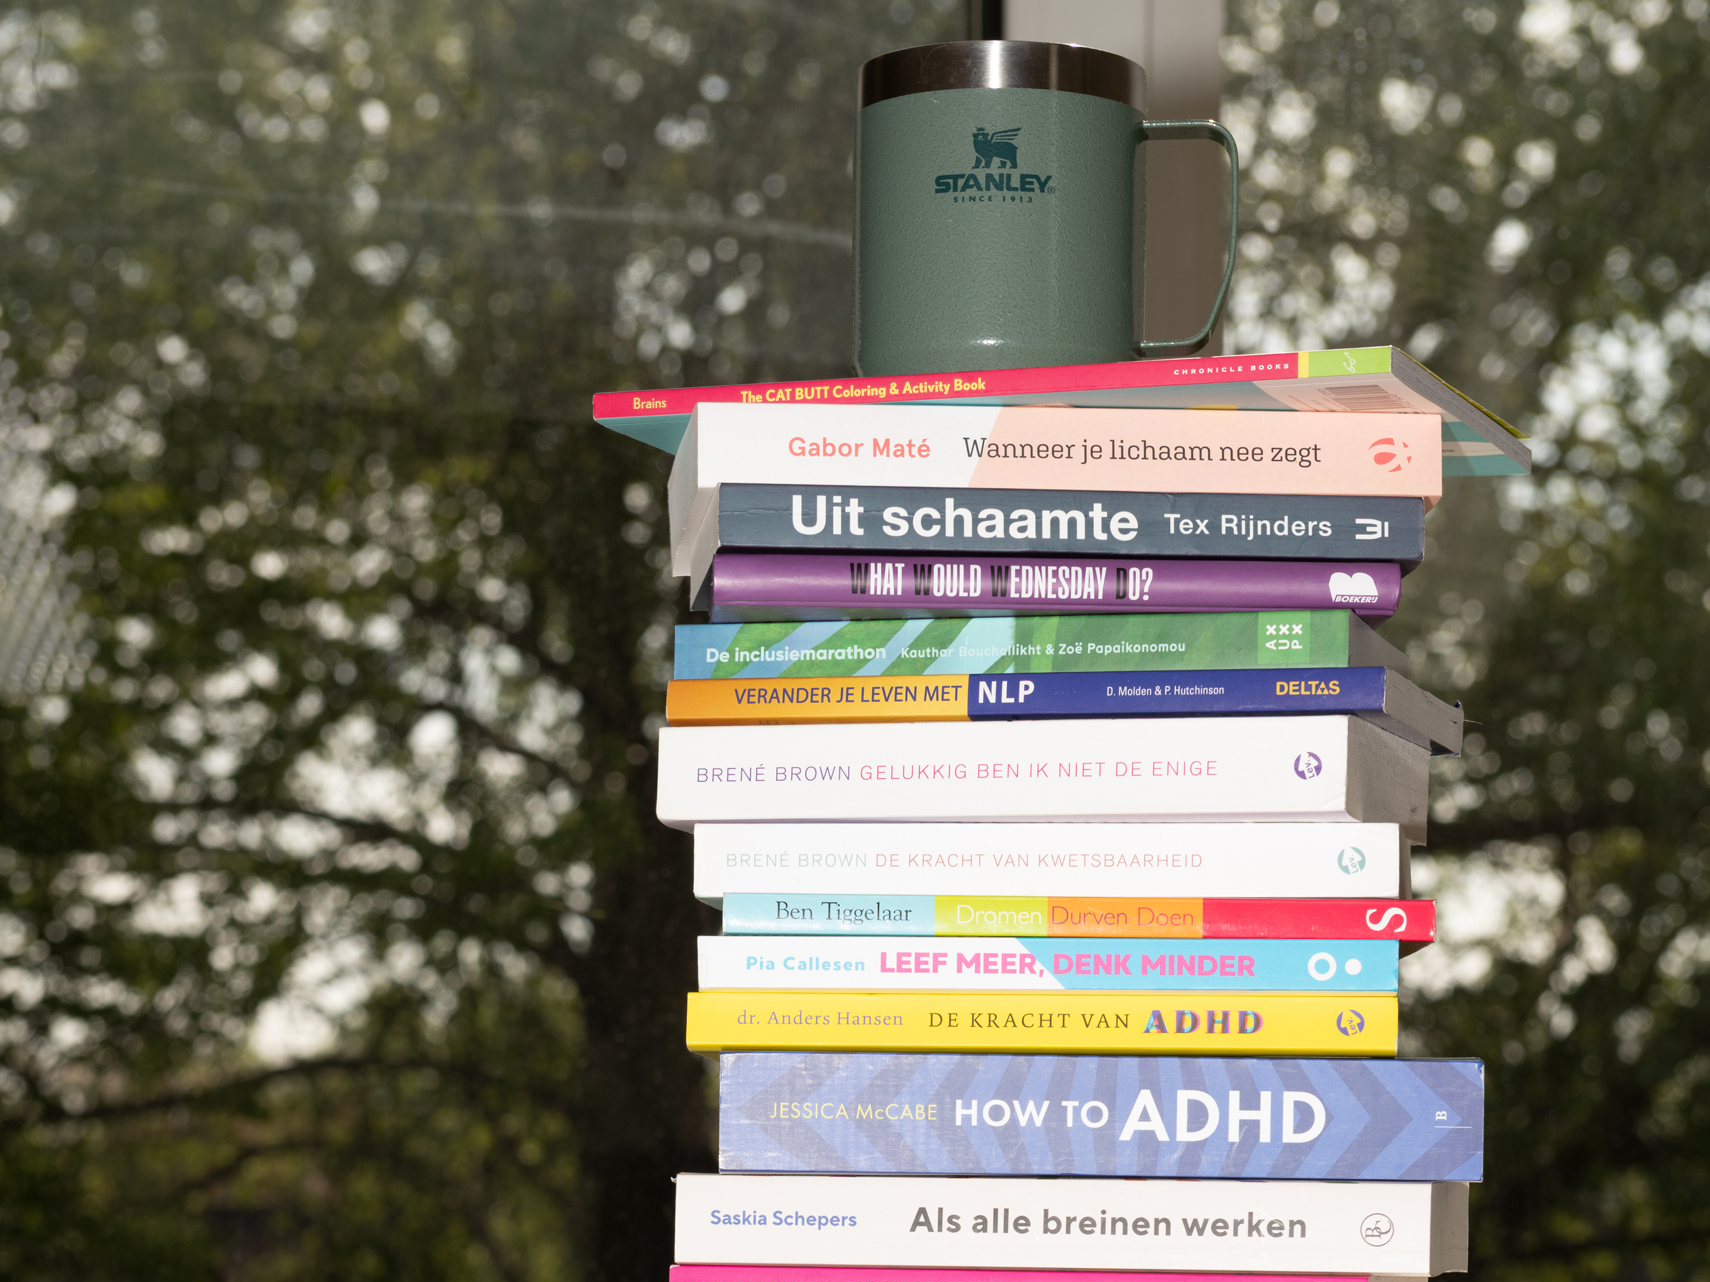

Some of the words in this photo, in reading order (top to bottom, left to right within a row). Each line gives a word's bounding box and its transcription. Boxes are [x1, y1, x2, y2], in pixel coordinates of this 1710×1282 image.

[953, 195, 993, 203] SINCE
[1002, 195, 1033, 203] 1913
[1173, 366, 1244, 376] CHRONICLE
[1250, 363, 1290, 373] BOOKS
[741, 391, 763, 403] The
[765, 388, 792, 402] CAT
[795, 386, 830, 400] BUTT
[832, 384, 887, 398] Coloring
[889, 382, 900, 395] &
[902, 380, 951, 395] Activity
[954, 377, 986, 392] Book
[633, 397, 667, 410] Brains
[788, 436, 864, 458] Gabor
[872, 437, 931, 459] Maté
[962, 437, 1075, 460] Wanneer
[1081, 440, 1103, 465] je
[1109, 439, 1213, 462] lichaam
[1218, 446, 1264, 462] nee
[1270, 443, 1322, 468] zegt
[792, 495, 865, 536] Uit
[882, 497, 1138, 541] schaamte
[1164, 513, 1210, 535] Tex
[1221, 514, 1333, 541] Rijnders
[850, 562, 905, 596] WHAT
[913, 563, 982, 597] WOULD
[990, 564, 1106, 600] WEDNESDAY
[1115, 566, 1154, 601] DO?
[706, 648, 731, 663] De
[735, 644, 886, 663] inclusiemarathon
[901, 645, 955, 659] Kauthar
[959, 642, 1041, 658] Bouchallikht
[1045, 643, 1055, 654] &
[1058, 640, 1083, 655] Zoë
[1087, 640, 1186, 656] Papaikonomou
[734, 687, 831, 705] VERANDER
[835, 686, 856, 704] JE
[861, 685, 918, 703] LEVEN
[923, 684, 962, 702] MET
[978, 680, 1035, 704] NLP
[1106, 686, 1115, 697] D.
[1118, 685, 1152, 697] Molden
[1154, 686, 1162, 696] &
[1164, 686, 1172, 696] P.
[1173, 684, 1225, 696] Hutchinson
[696, 763, 767, 783] BRENÉ
[775, 766, 851, 782] BROWN
[860, 764, 967, 781] GELUKKIG
[977, 763, 1020, 779] BEN
[1029, 762, 1049, 778] IK
[1058, 761, 1106, 778] NIET
[1115, 761, 1142, 778] DE
[1151, 760, 1218, 777] ENIGE
[726, 850, 790, 868] BRENÉ
[798, 853, 868, 868] BROWN
[875, 853, 900, 868] DE
[908, 853, 985, 868] KRACHT
[992, 853, 1029, 868] VAN
[1038, 853, 1202, 868] KWETSBAARHEID
[775, 901, 814, 921] Ben
[821, 901, 912, 925] Tiggelaar
[957, 904, 1042, 925] Dromen
[1051, 905, 1128, 926] Durven
[1137, 906, 1194, 927] Doen
[746, 956, 775, 971] Pia
[783, 956, 866, 971] Callesen
[880, 951, 948, 974] LEEF
[956, 952, 1044, 978] MEER,
[1053, 953, 1132, 976] DENK
[1141, 955, 1256, 977] MINDER
[737, 1009, 761, 1025] dr.
[767, 1010, 831, 1026] Anders
[836, 1011, 904, 1026] Hansen
[929, 1012, 959, 1028] DE
[970, 1012, 1070, 1029] KRACHT
[1081, 1013, 1130, 1029] VAN
[1143, 1009, 1264, 1034] ADHD
[769, 1102, 849, 1120] JESSICA
[855, 1103, 937, 1121] McCABE
[955, 1099, 1050, 1127] HOW
[1061, 1100, 1109, 1128] TO
[1118, 1088, 1326, 1143] ADHD
[710, 1209, 767, 1226] Saskia
[772, 1210, 858, 1230] Schepers
[909, 1206, 962, 1233] Als
[972, 1207, 1031, 1234] alle
[1042, 1208, 1172, 1237] breinen
[1181, 1211, 1307, 1238] werken
